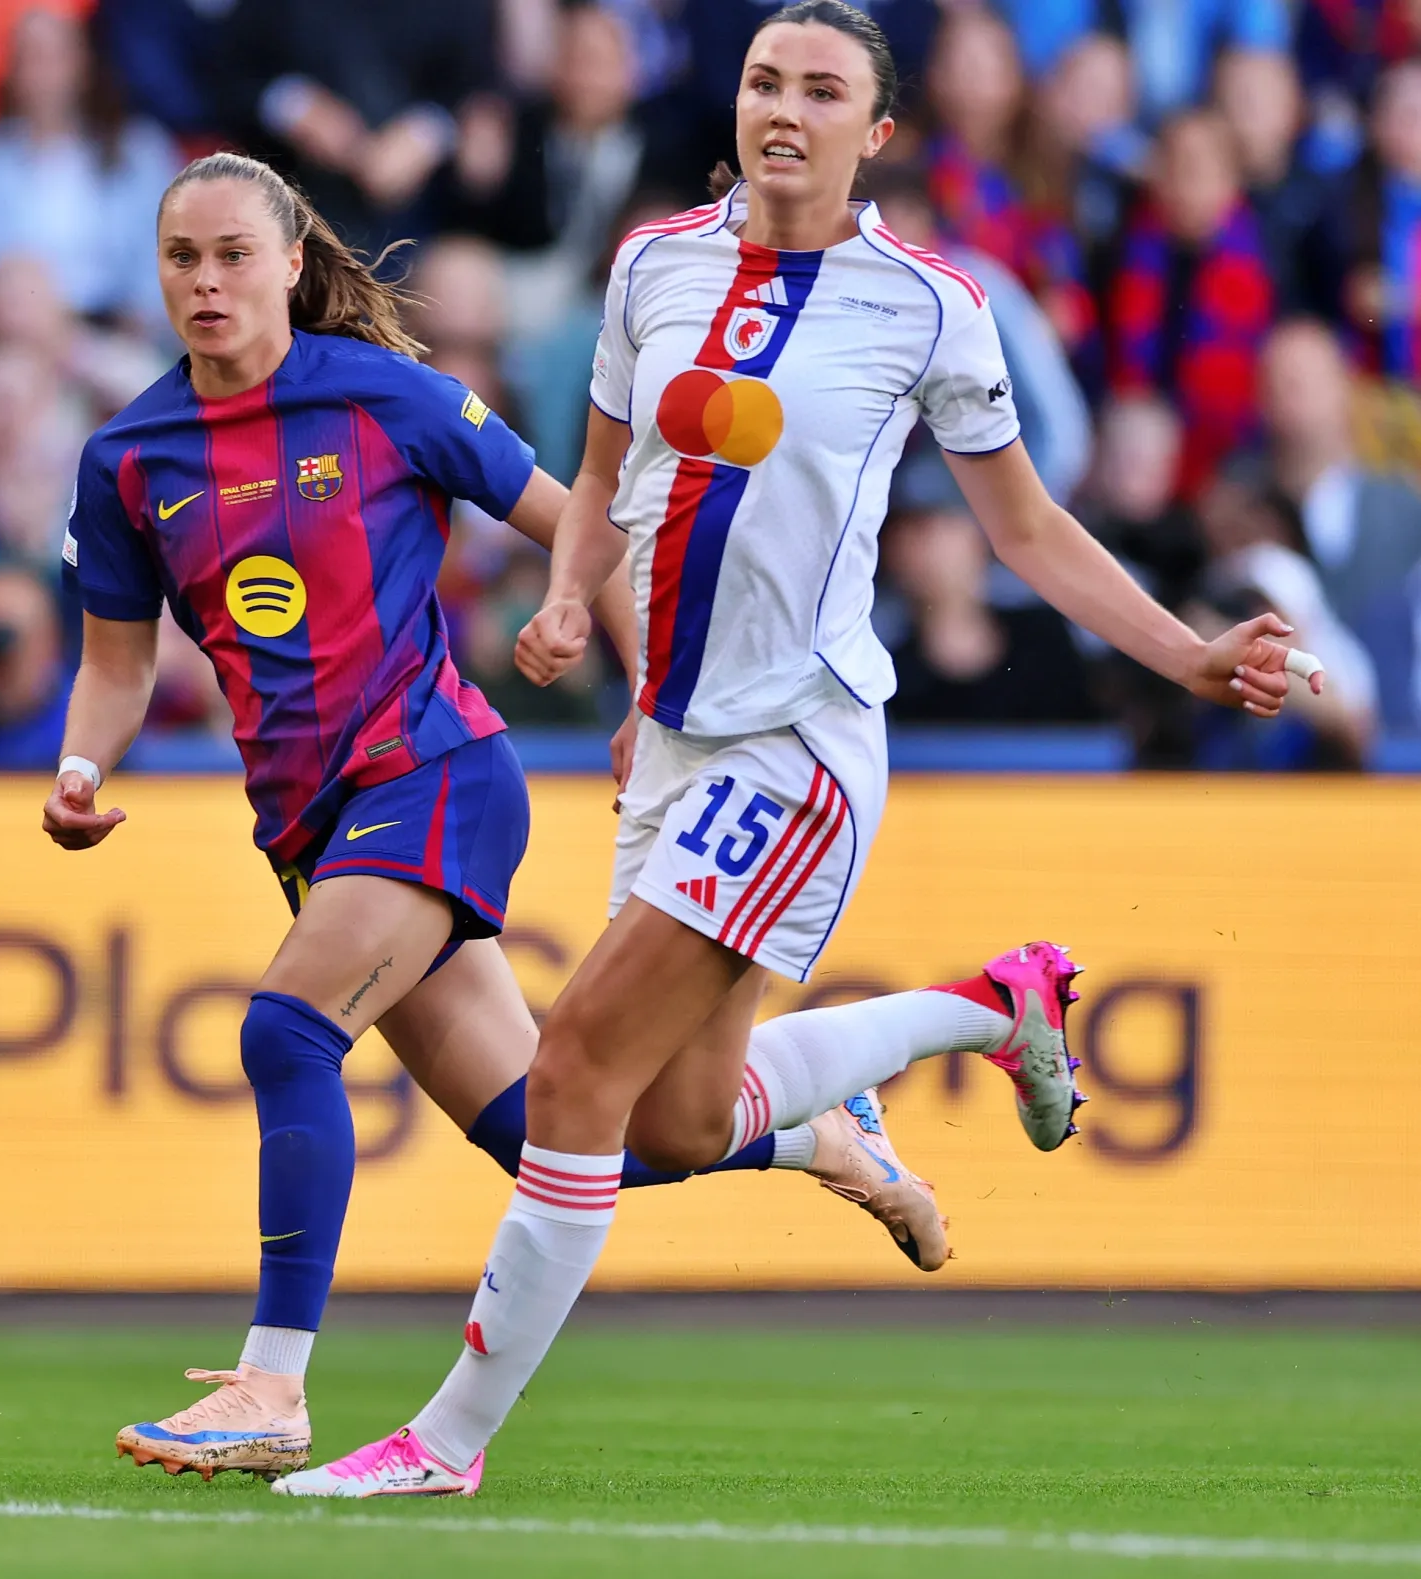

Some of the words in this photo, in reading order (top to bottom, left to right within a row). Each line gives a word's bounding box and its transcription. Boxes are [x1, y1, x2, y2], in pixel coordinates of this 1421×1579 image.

[861, 300, 880, 310] OSLO
[220, 486, 240, 495] FINAL
[240, 482, 258, 491] OSLO
[259, 479, 277, 487] 2026
[675, 775, 785, 877] 15
